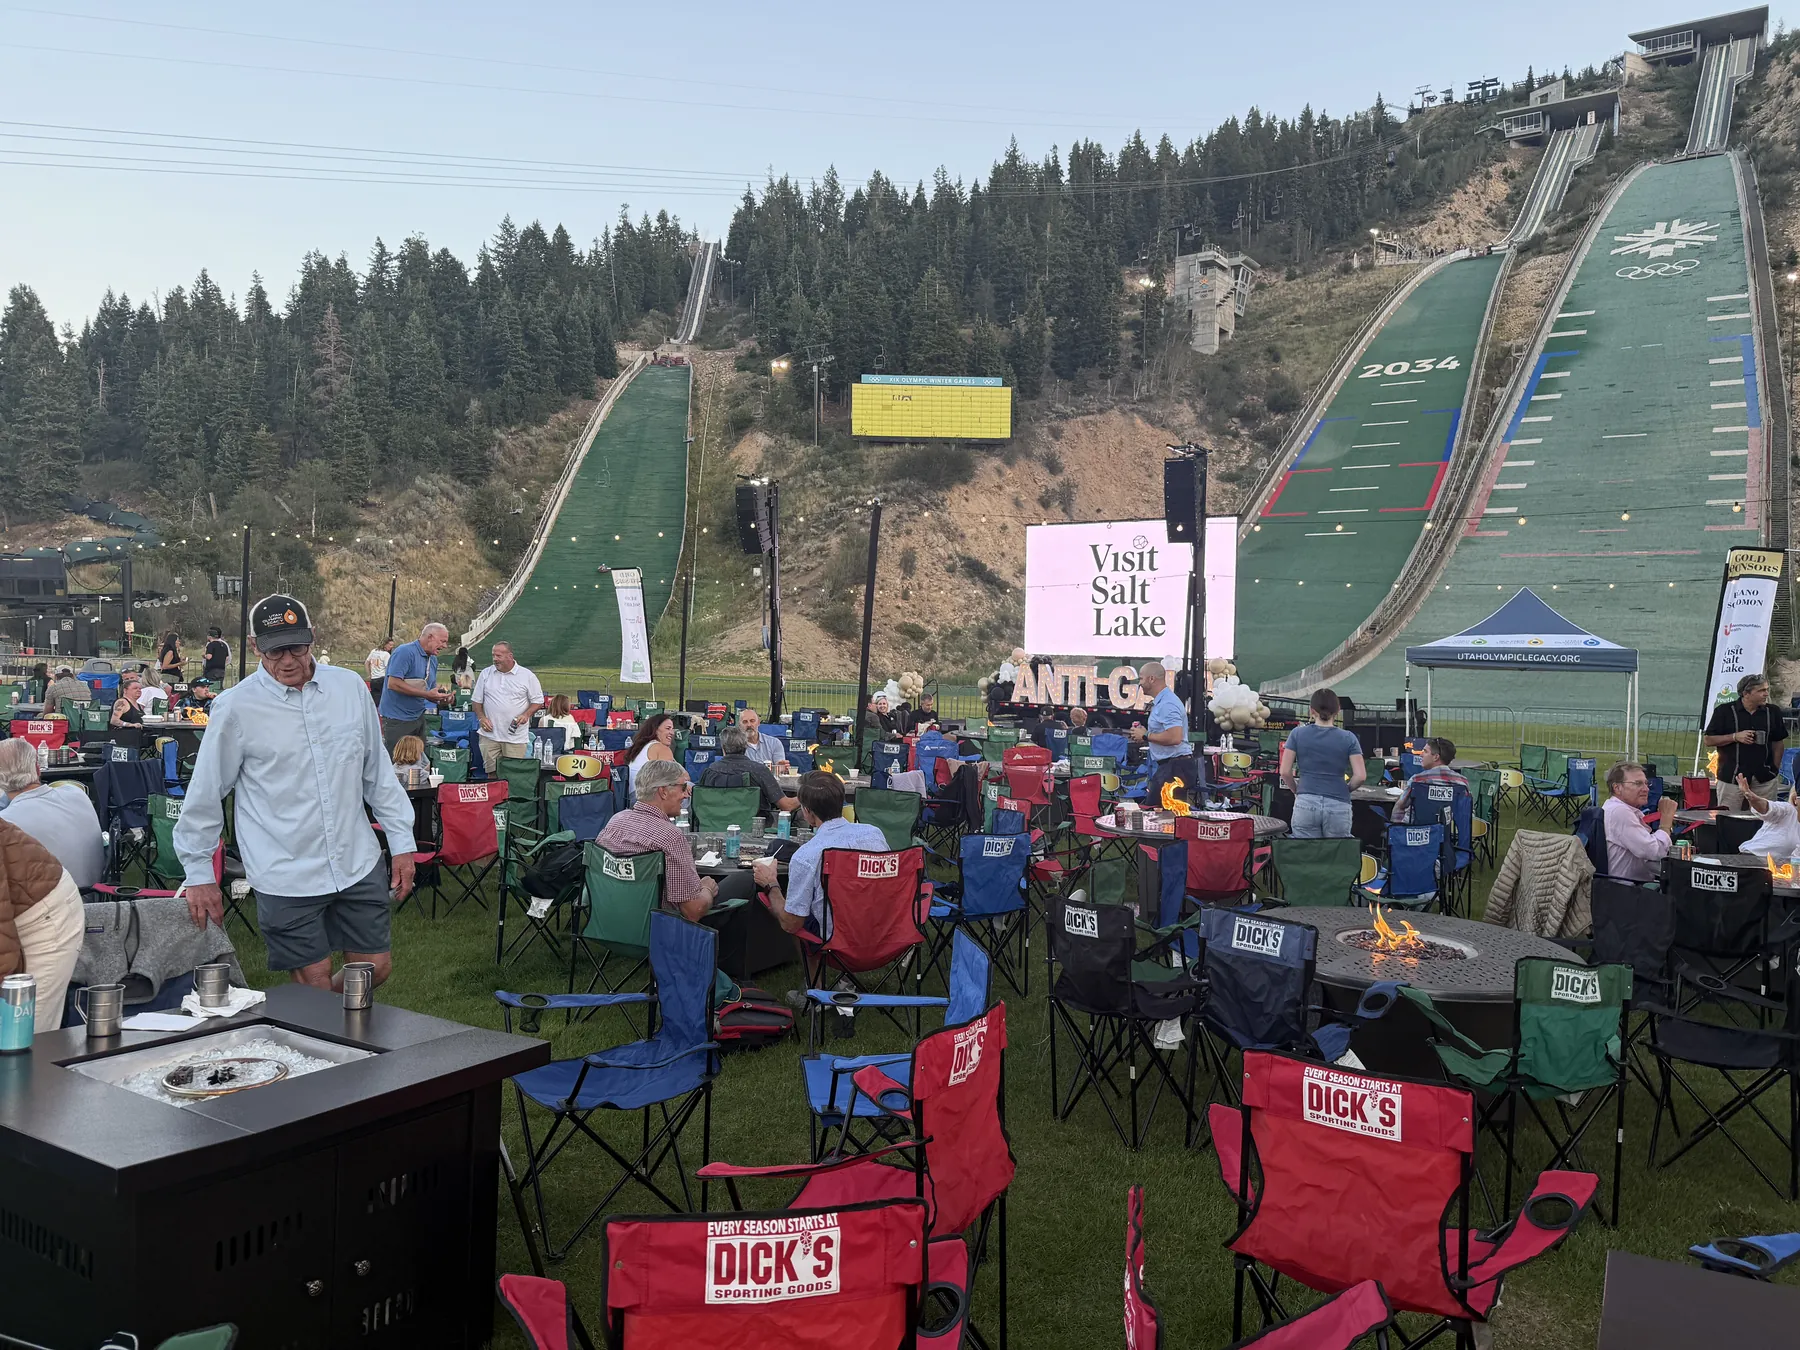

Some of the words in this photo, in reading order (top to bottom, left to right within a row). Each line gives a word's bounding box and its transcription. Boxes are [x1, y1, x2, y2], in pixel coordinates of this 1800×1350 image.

[1358, 355, 1460, 378] 2034
[1089, 543, 1159, 572] Visit
[1734, 554, 1766, 564] GOLD
[1729, 562, 1779, 574] PONSORS
[1092, 574, 1150, 604] Salt
[1092, 607, 1166, 638] Lake
[1457, 652, 1580, 663] UTAHOLYMPICLEGACY.ORG
[1721, 664, 1744, 674] Lake
[700, 737, 715, 746] DICK'S
[571, 758, 587, 770] 20
[1085, 758, 1103, 766] DICK'S
[1504, 772, 1509, 780] 2
[460, 787, 487, 798] DICK'S
[565, 785, 590, 794] DICK'S
[1430, 788, 1452, 798] DICK'S
[1200, 824, 1229, 836] DICK'S
[1408, 830, 1429, 842] DICK'S
[985, 840, 1013, 852] DICK'S
[860, 858, 897, 874] DICK'S
[1694, 872, 1735, 888] DICK'S
[1066, 911, 1096, 932] DICK'S
[1236, 924, 1280, 949] DICK'S
[1236, 941, 1264, 952] SPORTING
[1555, 973, 1597, 996] DICK'S
[1554, 991, 1584, 1001] SPORTING
[1304, 1066, 1328, 1080] EVERY
[1328, 1072, 1360, 1087] SEASON
[1361, 1078, 1390, 1093] STARTS
[1392, 1084, 1402, 1094] AT
[1308, 1082, 1396, 1128] DICK'S
[1309, 1112, 1357, 1129] SPORTING
[1360, 1124, 1396, 1137] GOODS
[708, 1220, 742, 1236] EVERY
[743, 1218, 786, 1234] SEASON
[787, 1214, 826, 1232] STARTS
[826, 1212, 839, 1227] AT
[714, 1234, 834, 1286] DICK'S
[714, 1287, 782, 1299] SPORTING
[788, 1280, 832, 1295] GOODS
